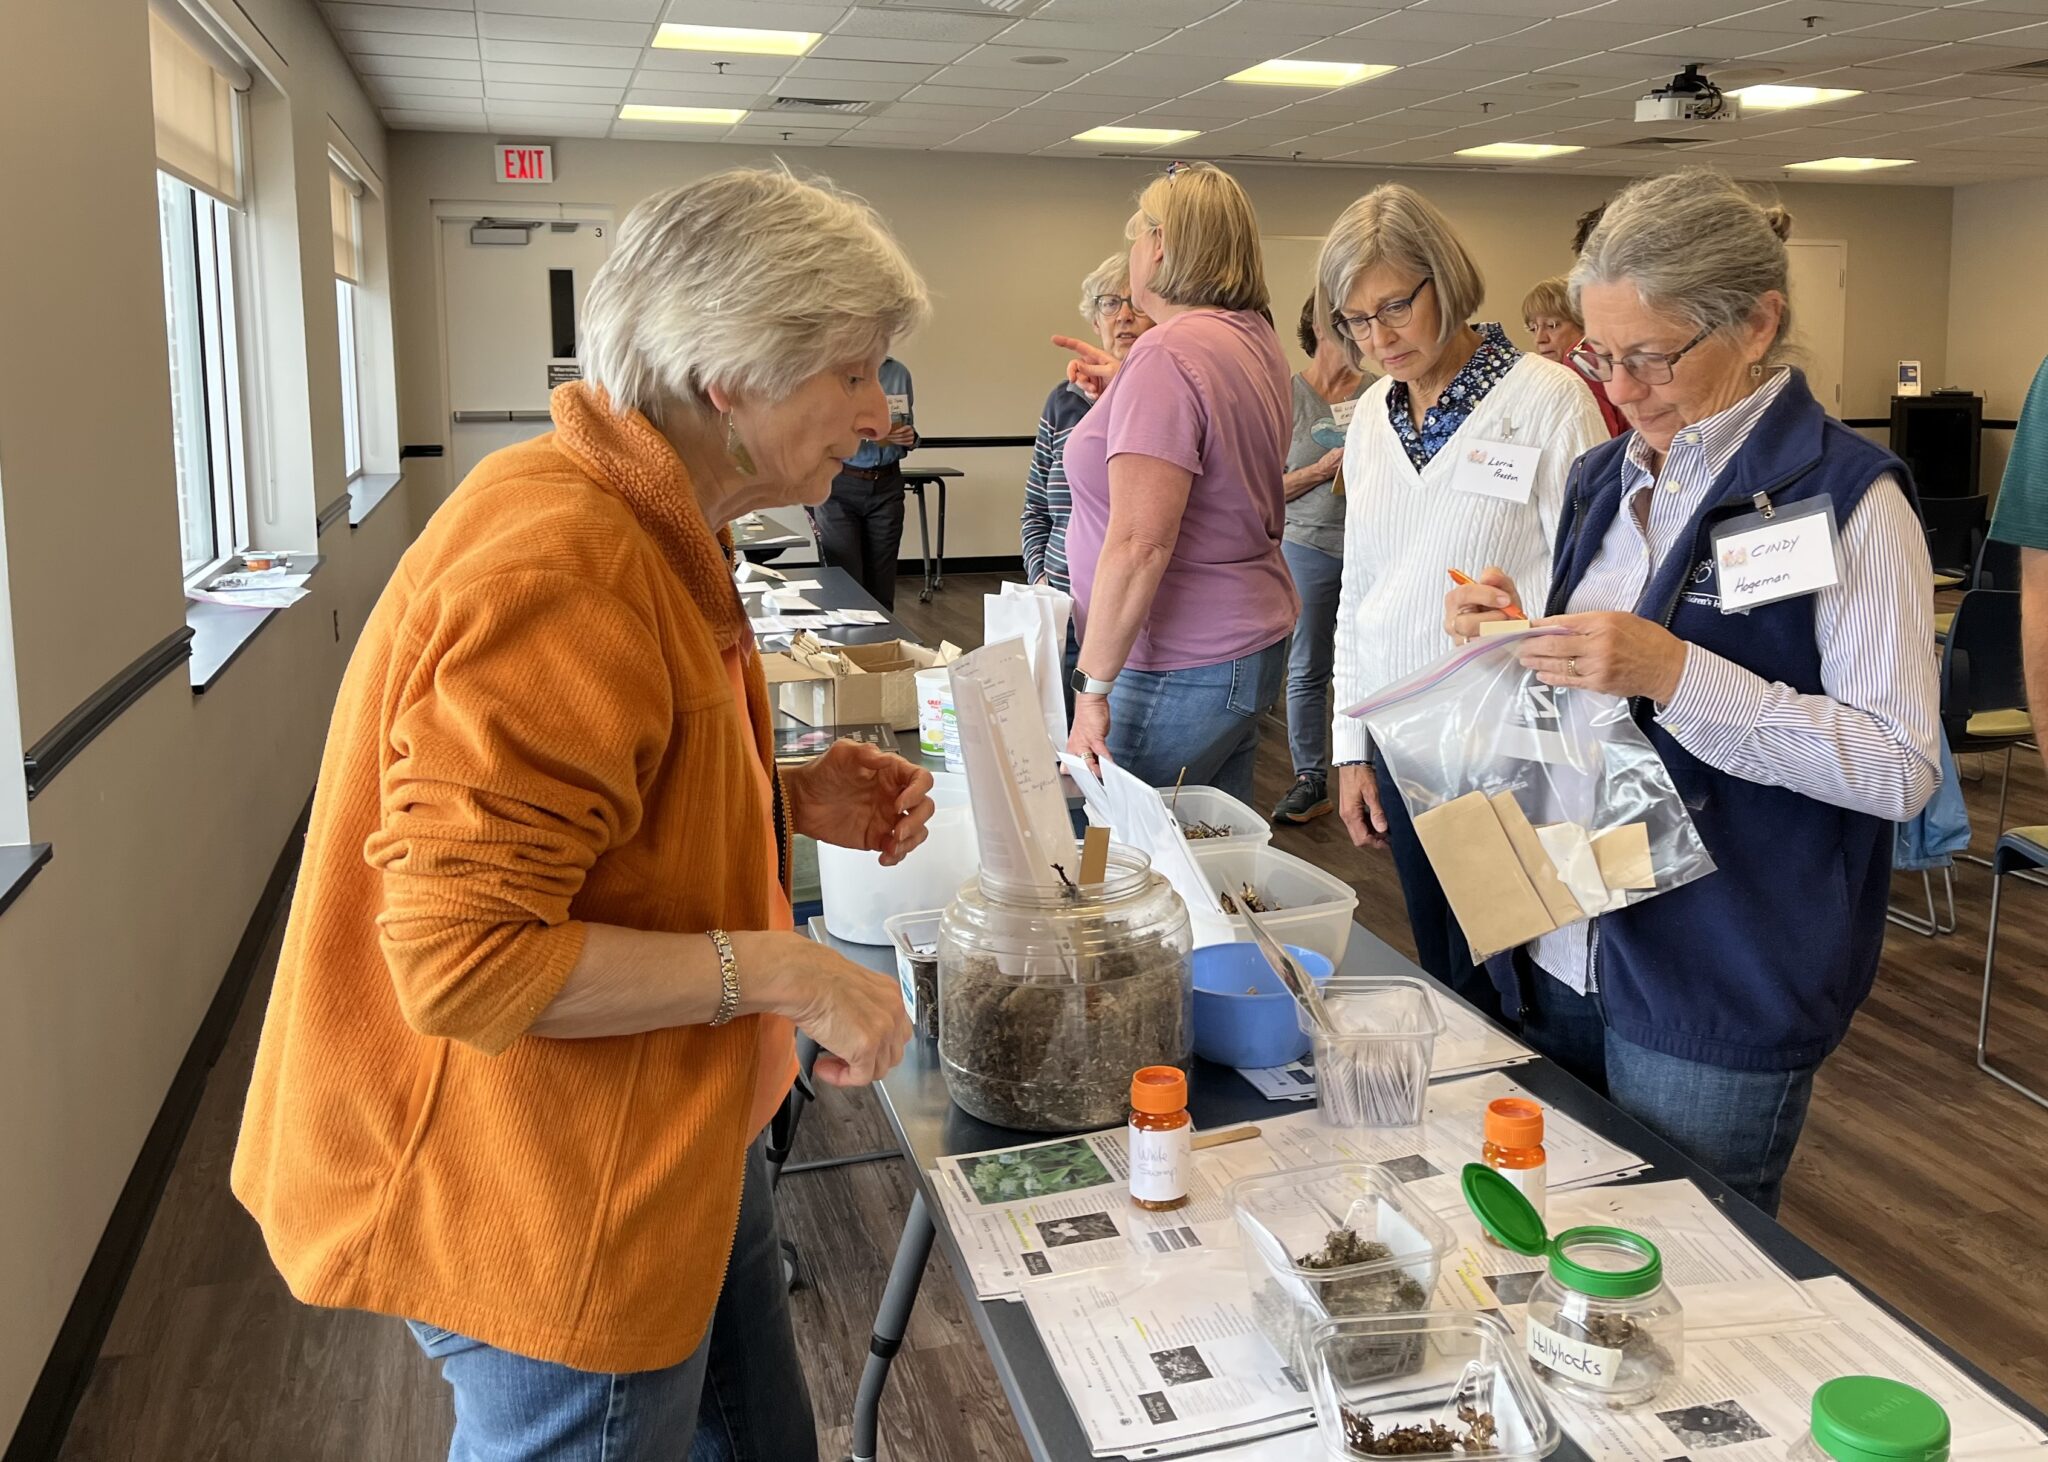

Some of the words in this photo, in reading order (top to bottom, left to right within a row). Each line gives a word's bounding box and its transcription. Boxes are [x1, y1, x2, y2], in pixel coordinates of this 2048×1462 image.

[504, 149, 544, 179] EXIT
[595, 227, 602, 238] 3
[1751, 535, 1800, 557] CINDY
[1532, 1327, 1602, 1376] Hollyhocks
